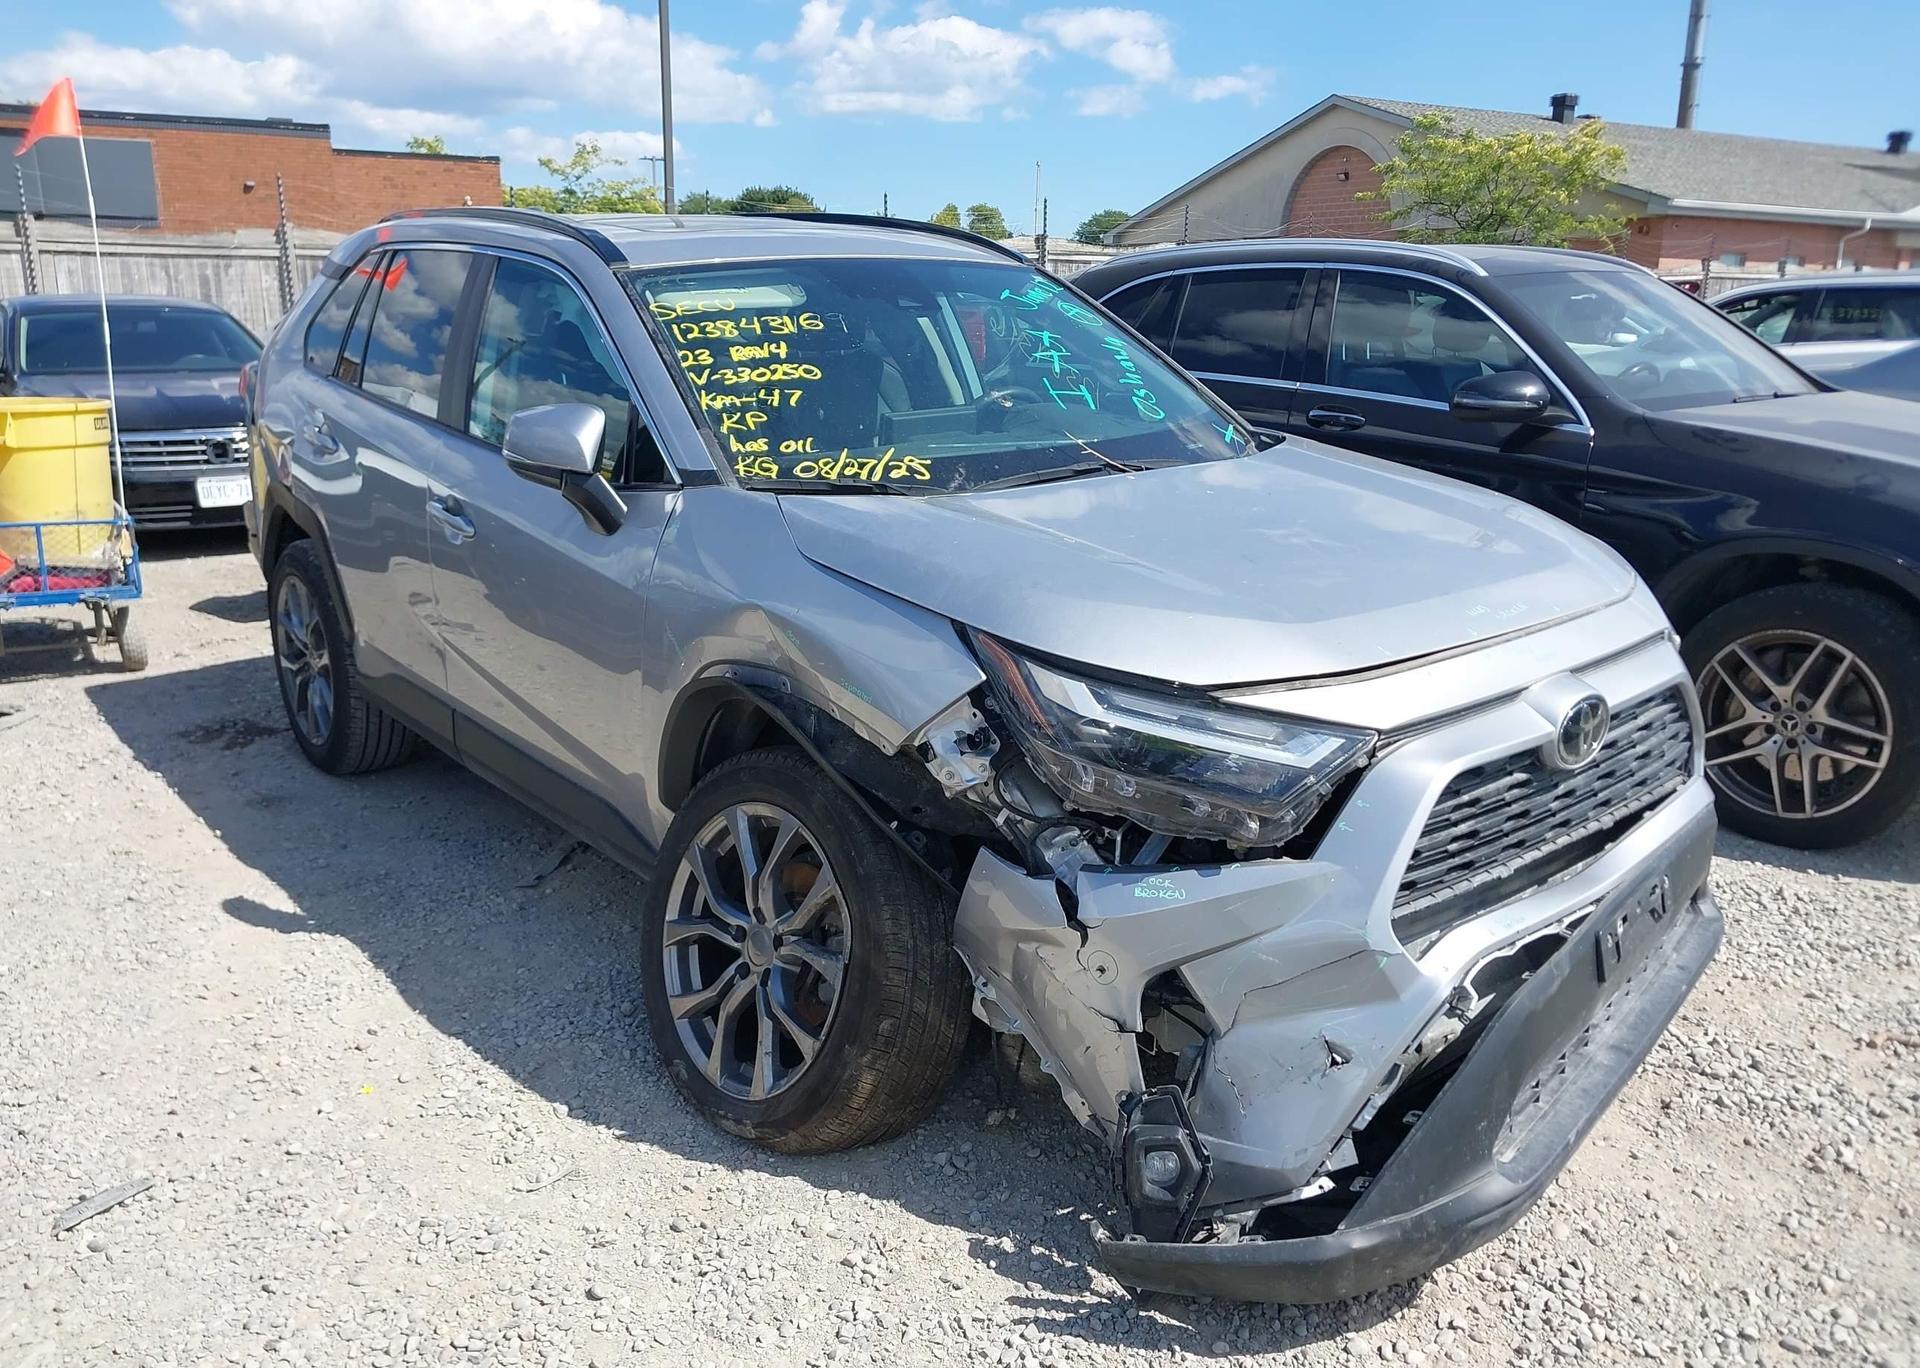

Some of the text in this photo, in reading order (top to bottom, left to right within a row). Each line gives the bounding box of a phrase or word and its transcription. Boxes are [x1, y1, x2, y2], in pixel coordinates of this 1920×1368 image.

[649, 298, 736, 320] SECU
[678, 349, 714, 367] 23
[720, 411, 767, 434] KP
[730, 435, 768, 453] has
[734, 448, 931, 482] KG 08/27/25
[1134, 887, 1186, 900] BROKEN
